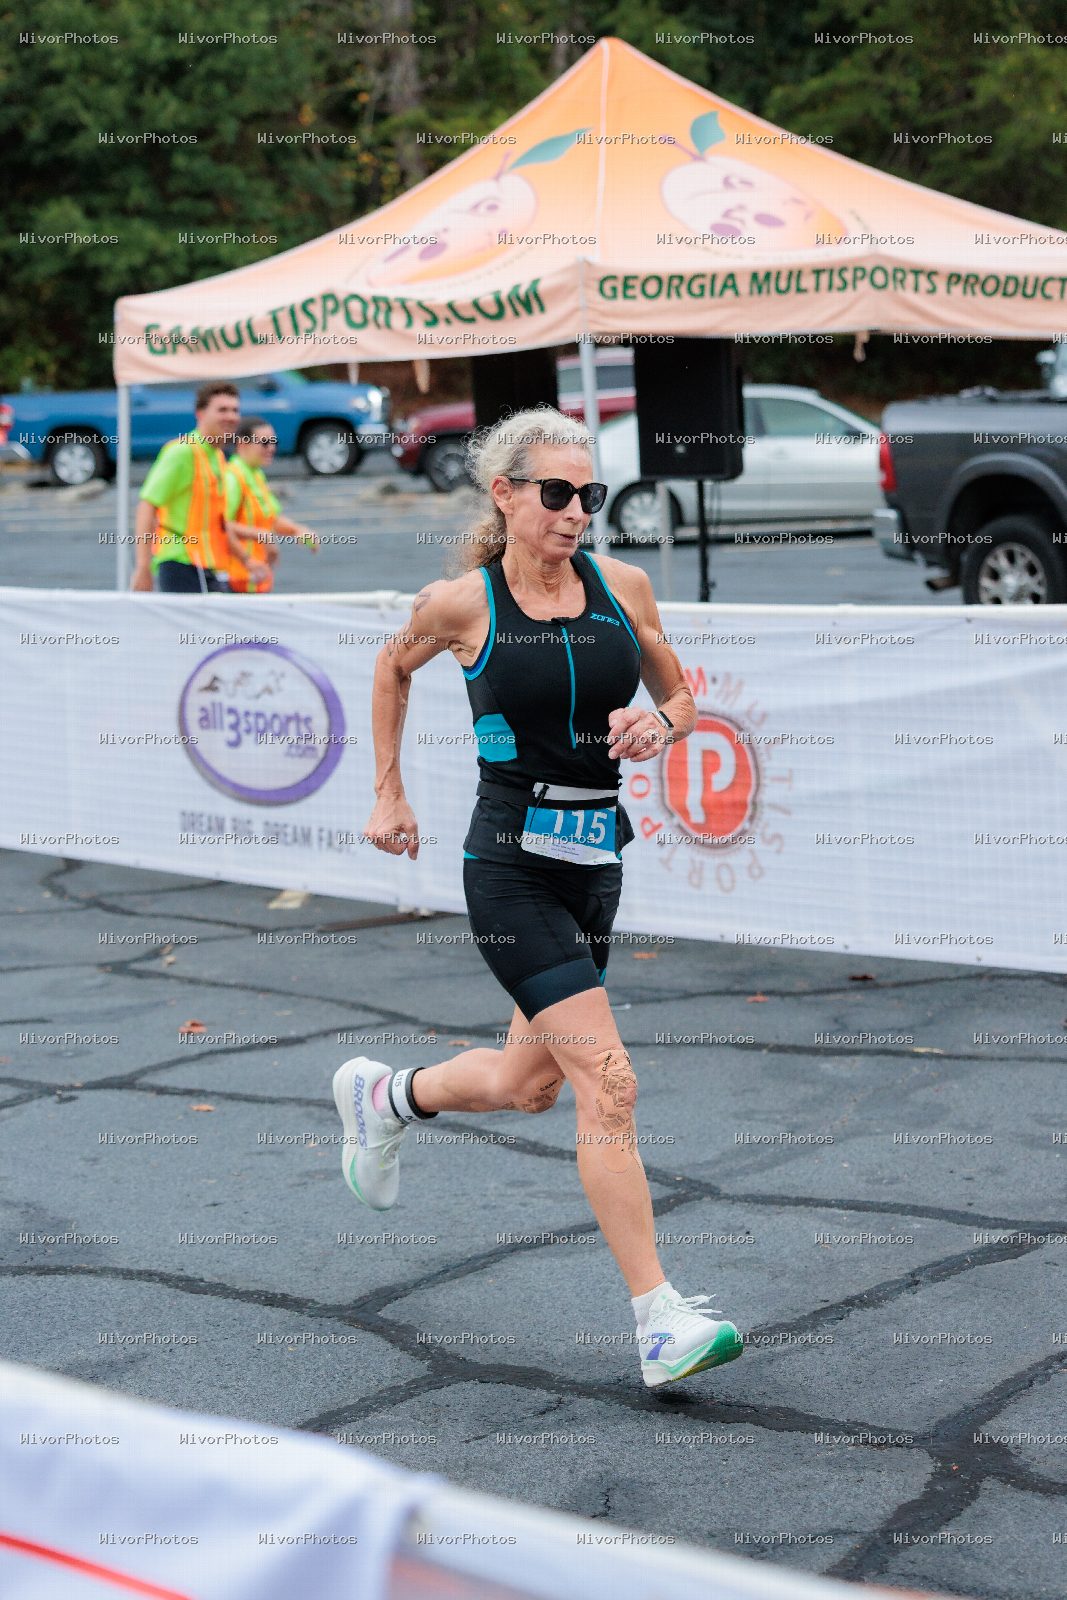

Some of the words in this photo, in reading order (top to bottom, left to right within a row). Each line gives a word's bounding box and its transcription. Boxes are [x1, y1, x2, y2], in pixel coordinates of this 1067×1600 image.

[598, 272, 739, 300] GEORGIA
[749, 265, 937, 295] MULTISPORTS
[197, 702, 314, 749] all3sports
[551, 809, 608, 845] 115
[353, 1073, 369, 1148] BROOKS
